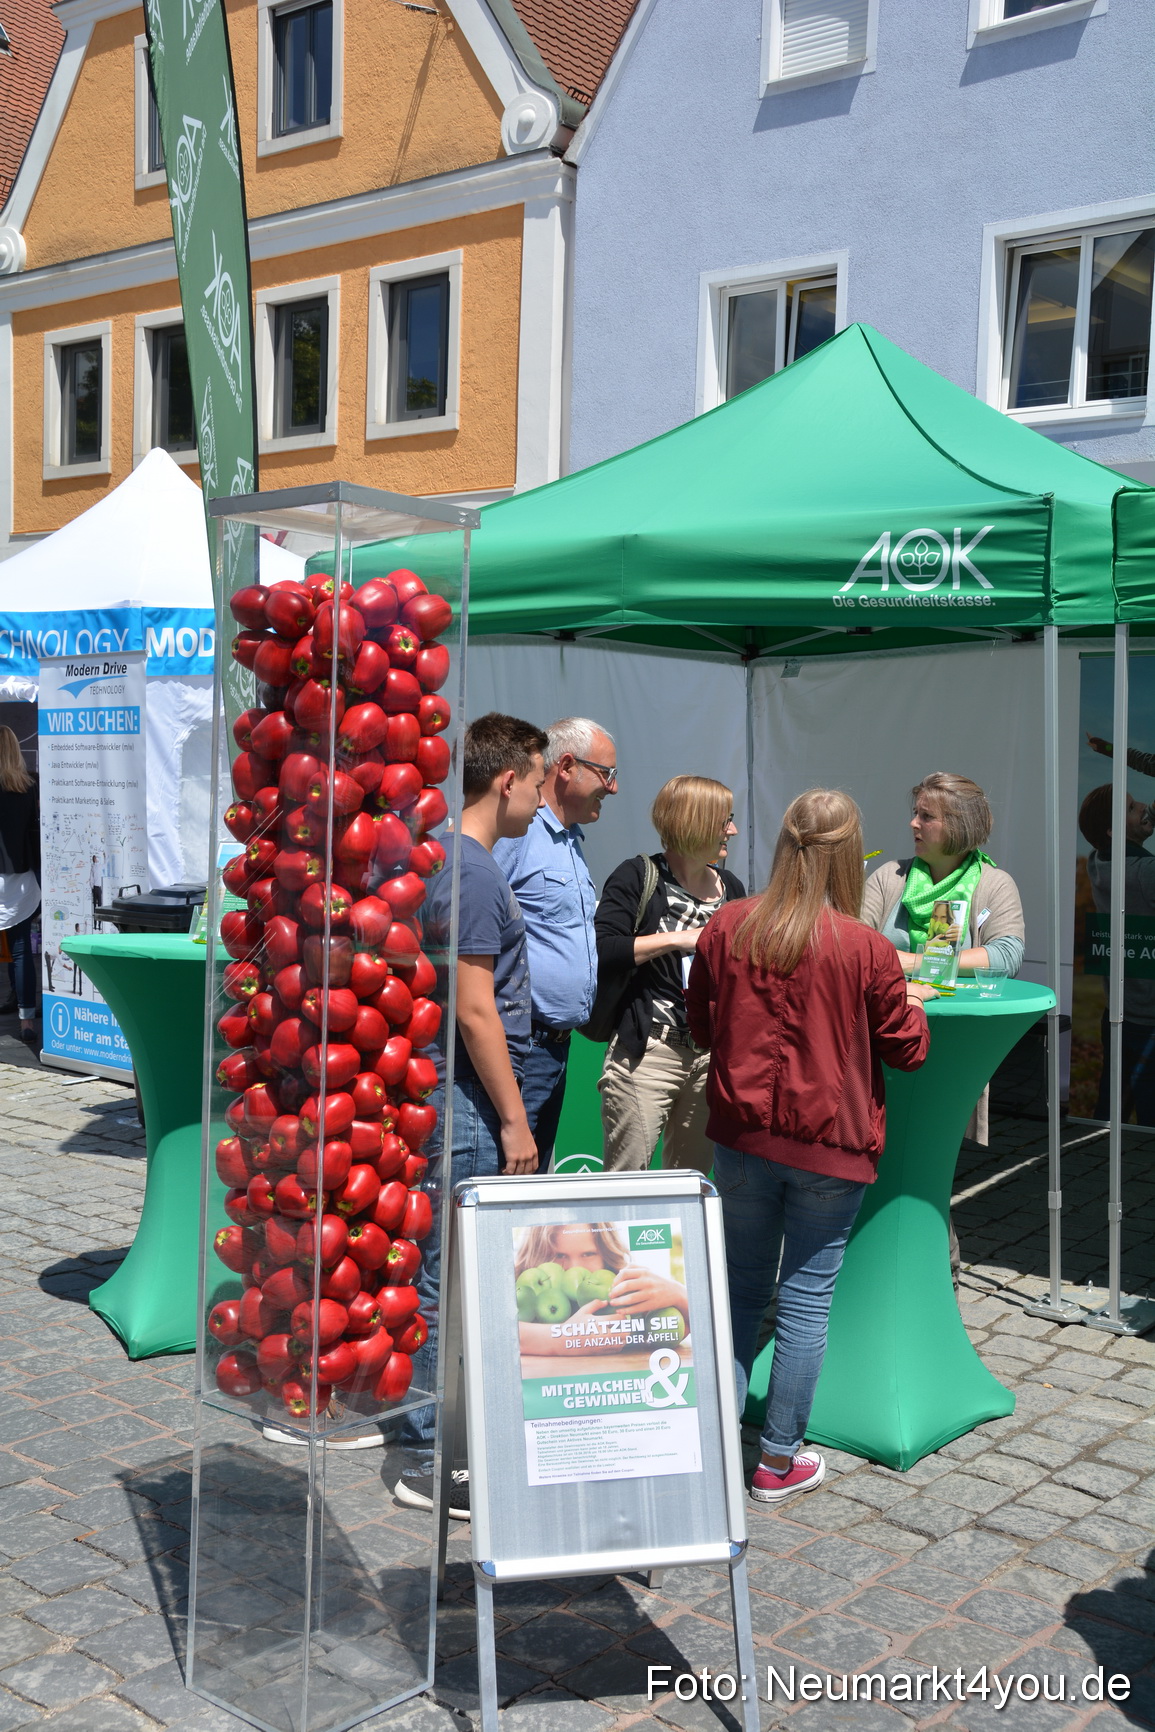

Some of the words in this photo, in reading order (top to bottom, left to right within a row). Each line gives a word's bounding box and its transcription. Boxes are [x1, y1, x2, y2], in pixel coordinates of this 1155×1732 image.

[838, 525, 996, 592] AOK
[832, 595, 856, 608] Die
[858, 594, 996, 608] Gesundheitskasse.
[65, 664, 99, 677] Modern
[102, 662, 127, 674] Drive
[89, 685, 126, 696] TECHNOLOGY
[47, 711, 74, 732] WIR
[78, 710, 138, 732] SUCHEN:
[1092, 943, 1136, 959] Mee
[74, 1006, 109, 1025] Nähere
[51, 1039, 65, 1050] Oder
[74, 1026, 94, 1042] hier
[96, 1034, 112, 1047] am
[637, 1229, 664, 1242] AOK
[551, 1318, 645, 1338] SCHÄTZEN
[650, 1316, 678, 1331] SIE
[565, 1338, 581, 1349] DIE
[584, 1336, 623, 1347] ANZAHL
[626, 1334, 645, 1344] DER
[647, 1332, 679, 1344] ÄPFEL!
[541, 1378, 646, 1398] MITMACHEN
[645, 1348, 689, 1408] &
[563, 1390, 654, 1409] GEWINNEN
[531, 1418, 603, 1429] Teilnahmebedingungen:
